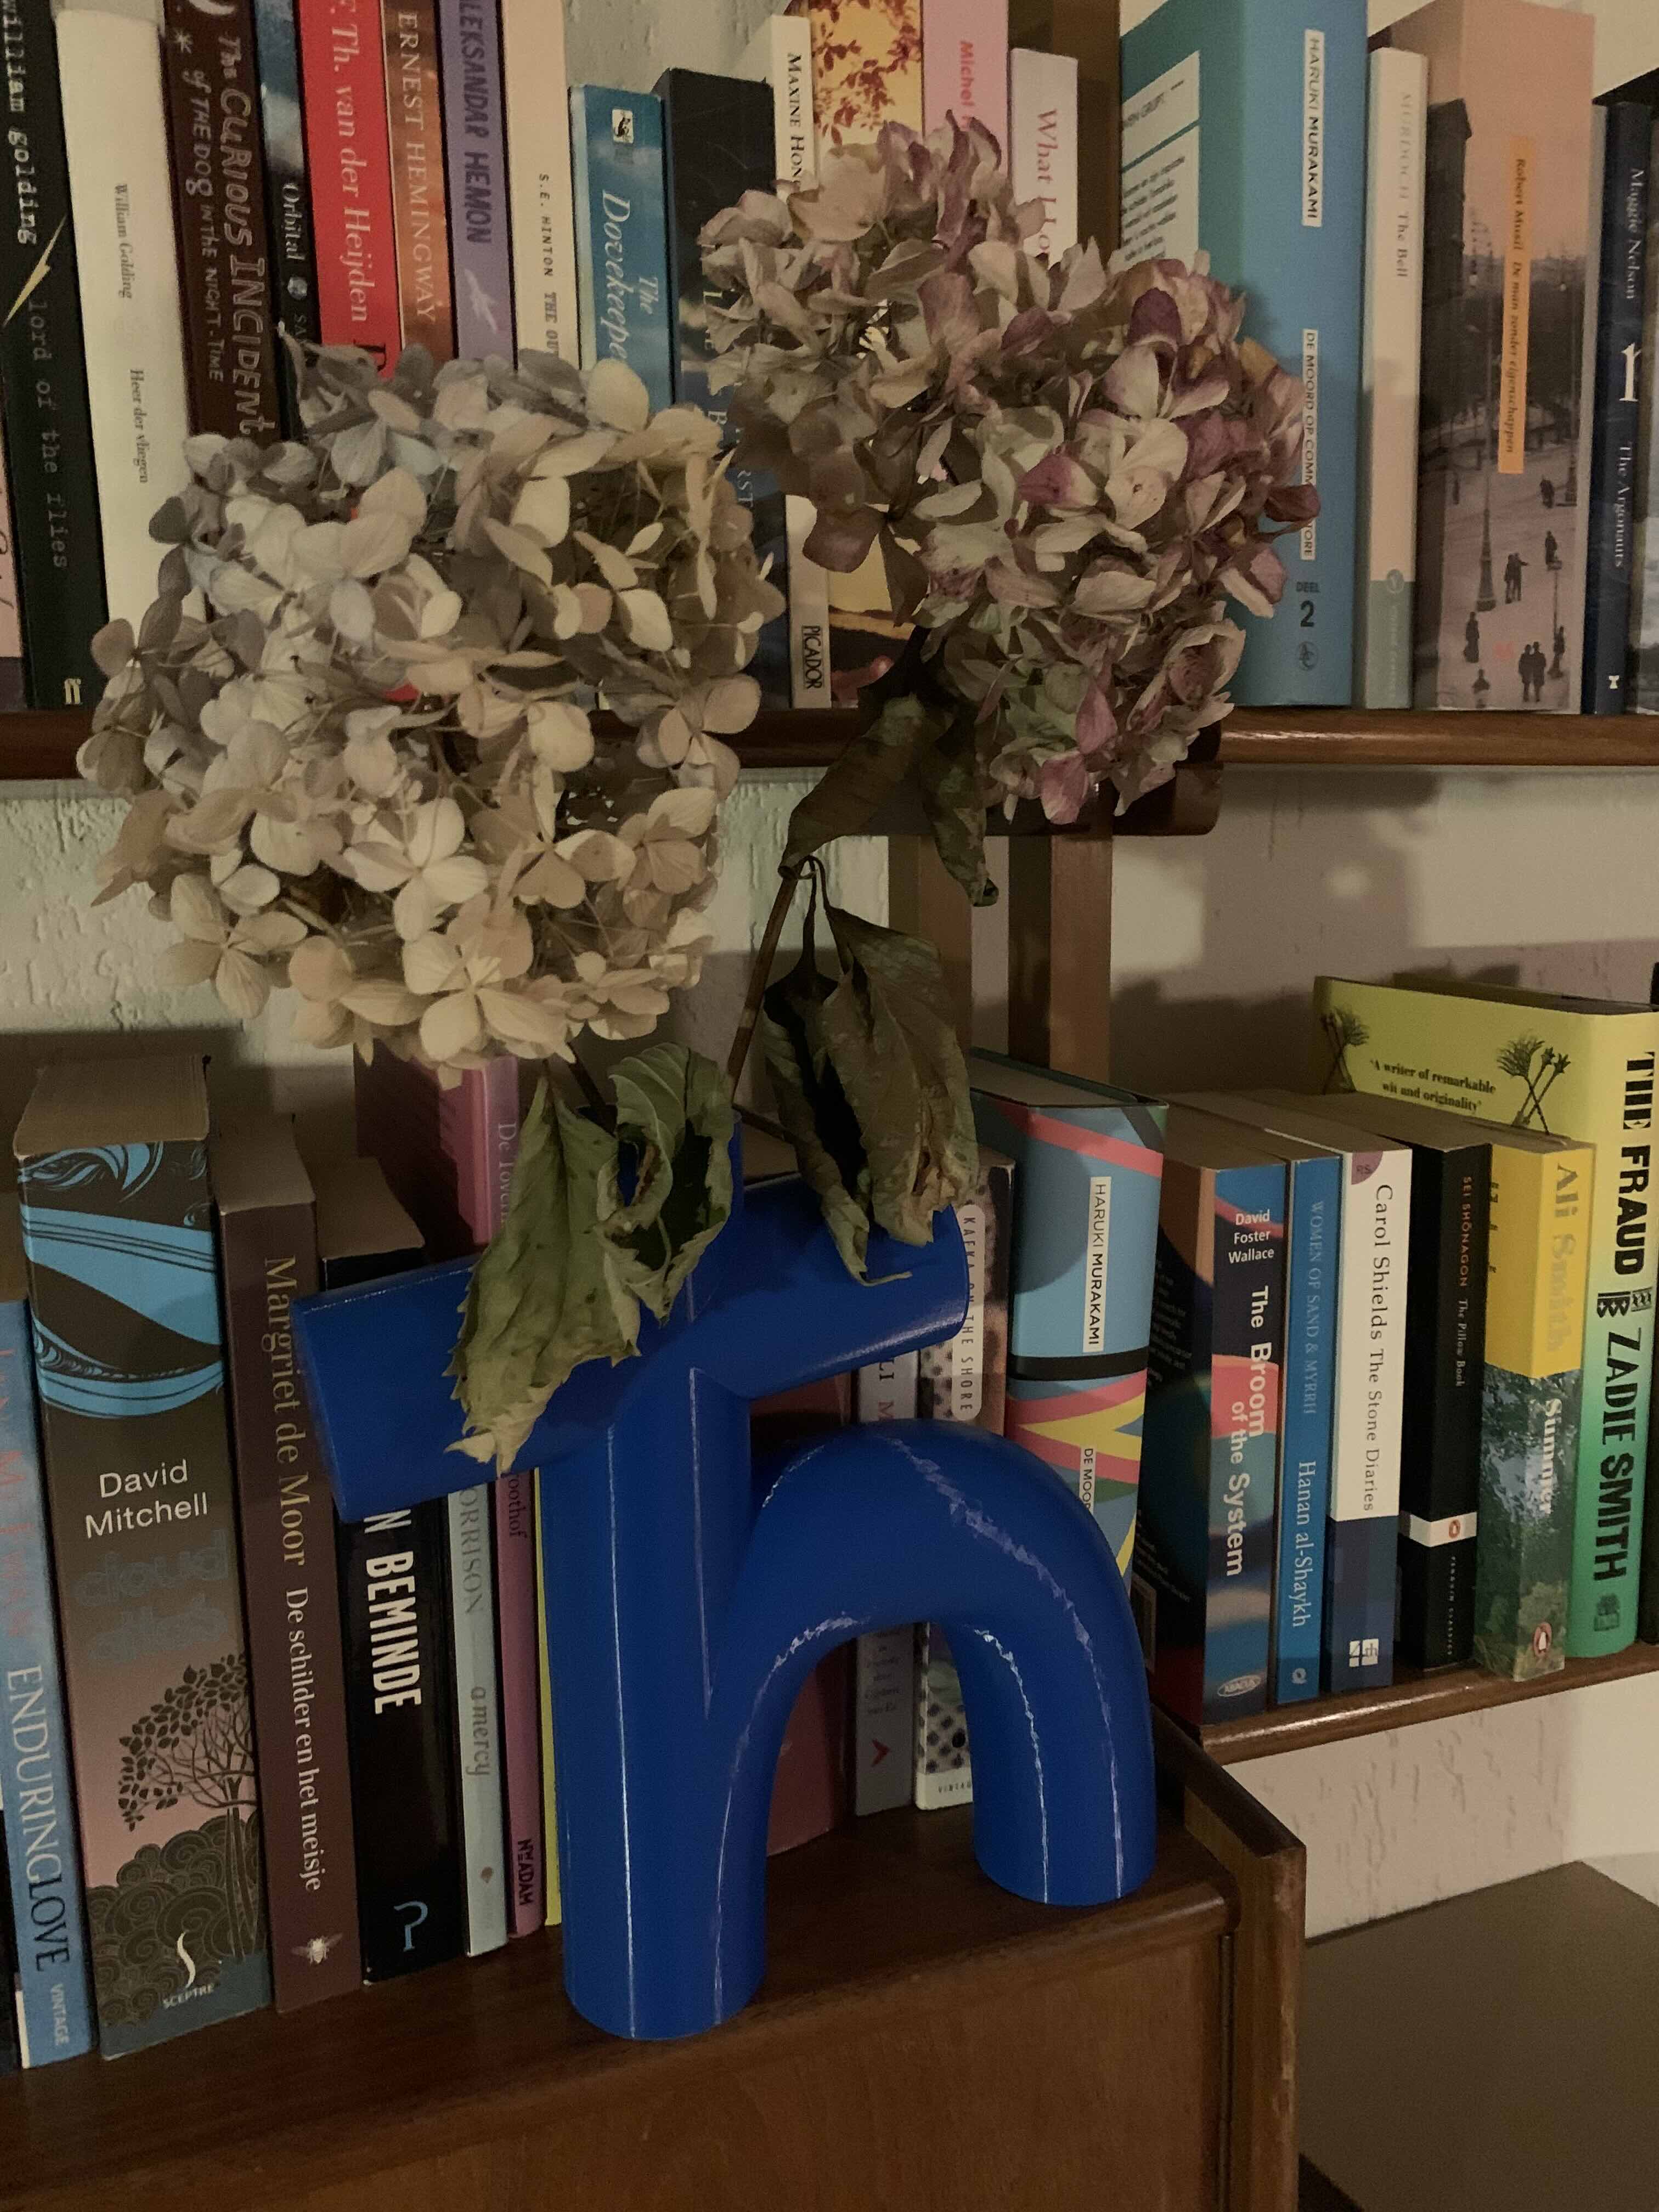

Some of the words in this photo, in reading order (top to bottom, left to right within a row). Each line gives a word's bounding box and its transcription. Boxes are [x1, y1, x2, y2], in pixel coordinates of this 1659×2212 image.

[331, 23, 360, 72] Th.
[398, 11, 424, 131] ERNEST
[459, 0, 489, 138] LEKSANDAR
[787, 54, 804, 127] MAXINE
[960, 41, 975, 107] Michel
[1307, 37, 1320, 112] HARUKI
[190, 98, 212, 140] THE
[335, 86, 356, 137] van
[789, 135, 805, 182] HON
[1037, 109, 1058, 183] What
[1307, 115, 1319, 219] MURAKAMI
[7, 127, 39, 245] golding
[339, 147, 367, 198] der
[464, 151, 492, 244] HEMON
[1515, 159, 1526, 206] Robert
[115, 183, 130, 236] William
[281, 182, 305, 261] Orbital
[1626, 168, 1645, 234] Maggie
[406, 140, 436, 323] HEMINGWAY
[541, 216, 553, 276] HINTON
[1397, 213, 1409, 242] The
[1513, 210, 1524, 250] Musil
[119, 242, 134, 299] Golding
[339, 206, 375, 321] Heijden
[601, 189, 635, 360] Dovekeepe
[1396, 248, 1408, 278] Bell
[1512, 261, 1521, 278] De
[1626, 239, 1642, 299] Nelson
[545, 292, 557, 324] THE
[638, 275, 659, 315] The
[1511, 282, 1520, 311] man
[29, 300, 53, 361] lord
[1306, 332, 1314, 349] DE
[1509, 314, 1521, 356] zonder
[35, 380, 56, 410] of
[131, 368, 145, 405] Heer
[1306, 354, 1314, 410] MOORD
[1504, 358, 1519, 453] eigenschappen
[133, 408, 148, 430] der
[1305, 415, 1314, 436] OP
[41, 429, 59, 474] the
[133, 433, 150, 484] vliegen
[1618, 442, 1633, 476] The
[46, 492, 69, 568] flies
[1615, 483, 1631, 568] Argonauts
[1300, 599, 1316, 628] 2
[803, 625, 822, 690] PICADOR
[1382, 1082, 1397, 1093] wit
[1401, 1085, 1420, 1099] and
[1384, 1063, 1415, 1079] writer
[1419, 1069, 1430, 1080] of
[1432, 1073, 1496, 1094] remarkable
[1623, 1052, 1655, 1130] THE
[498, 1121, 517, 1150] De
[1461, 1176, 1473, 1198] SEI
[1555, 1163, 1579, 1218] Ali
[1615, 1145, 1650, 1274] FRAUD
[1092, 1183, 1106, 1248] HARUKI
[1233, 1230, 1271, 1245] Foster
[1235, 1209, 1271, 1226] David
[1310, 1200, 1325, 1263] WOMEN
[1373, 1184, 1393, 1246] Carol
[1228, 1246, 1275, 1265] Wallace
[1308, 1268, 1322, 1290] OF
[1088, 1252, 1103, 1345] MURAKAMI
[1250, 1285, 1269, 1329] The
[1306, 1295, 1322, 1337] SAND
[1370, 1256, 1391, 1340] Shields
[1457, 1299, 1469, 1319] The
[261, 1255, 301, 1414] Margriet
[961, 1314, 974, 1345] THE
[1455, 1322, 1467, 1356] Pillow
[960, 1356, 973, 1411] SHORE
[1249, 1341, 1273, 1437] Broom
[1368, 1348, 1385, 1384] The
[1455, 1359, 1466, 1387] Book
[1602, 1327, 1641, 1445] ZADIE
[1231, 1401, 1249, 1423] of
[1366, 1390, 1383, 1442] Stone
[276, 1422, 307, 1466] de
[1084, 1448, 1093, 1464] DE
[1229, 1429, 1249, 1465] the
[1540, 1397, 1562, 1516] Summer
[99, 1458, 189, 1499] David
[1295, 1461, 1316, 1526] Hanan
[1363, 1448, 1380, 1511] Diaries
[84, 1491, 209, 1539] Mitchell
[279, 1472, 311, 1568] Moor
[1224, 1472, 1251, 1577] System
[1594, 1451, 1634, 1581] SMITH
[459, 1486, 484, 1615] ORRISON
[285, 1586, 309, 1625] De
[1292, 1532, 1315, 1628] al-Shaykh
[365, 1550, 422, 1716] BEMINDE
[288, 1629, 316, 1728] schilder
[470, 1686, 487, 1701] a
[295, 1731, 313, 1765] en
[466, 1705, 490, 1776] mercy
[298, 1767, 320, 1808] het
[299, 1813, 327, 1893] meisje
[27, 1874, 70, 1972] LOVE
[50, 1983, 70, 2045] VINTAGE
[163, 1983, 215, 2009] SCEPTRE
